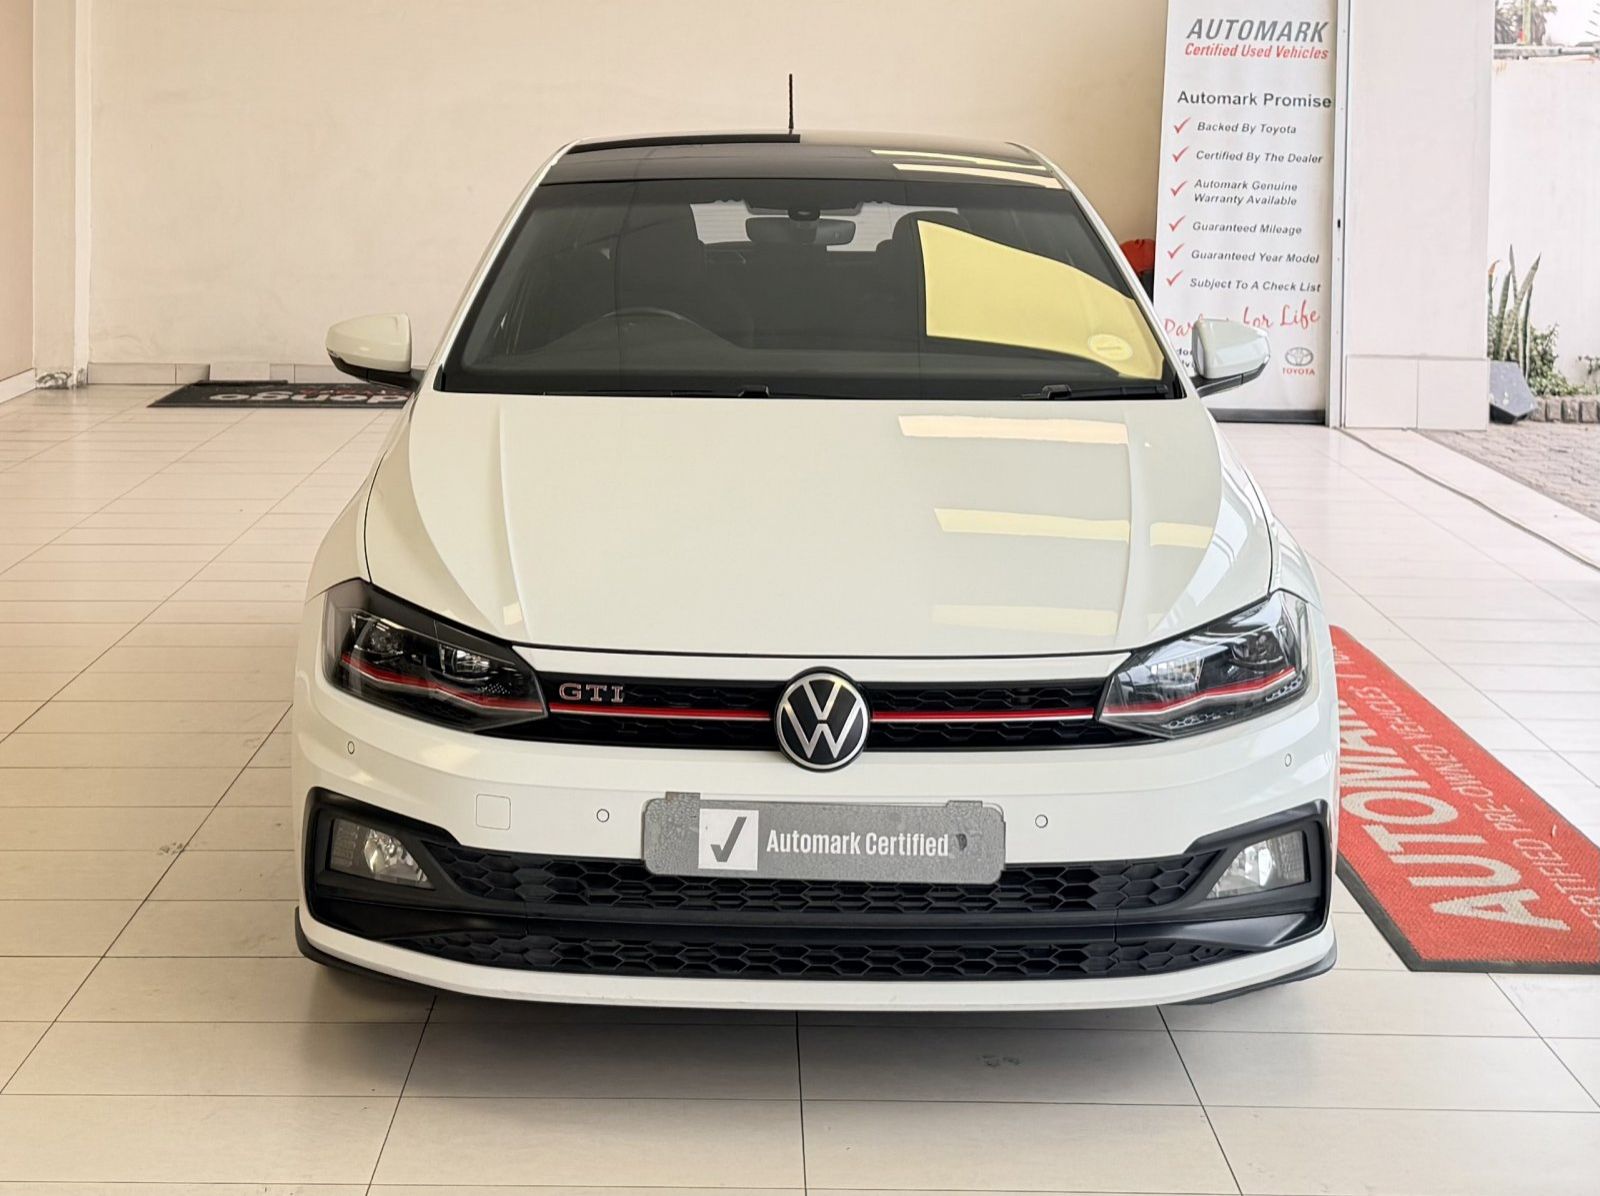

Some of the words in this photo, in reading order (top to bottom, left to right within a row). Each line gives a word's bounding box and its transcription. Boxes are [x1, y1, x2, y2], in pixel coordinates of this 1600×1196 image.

[1186, 18, 1329, 43] AUTOMARK
[1185, 42, 1237, 57] Certified
[1241, 44, 1271, 58] Used
[1276, 45, 1329, 60] Vehicles
[1177, 91, 1258, 106] Automark
[1263, 93, 1332, 109] Promise
[1197, 121, 1239, 133] Backed
[1241, 123, 1256, 134] By
[1260, 124, 1297, 135] Toyota
[1196, 150, 1243, 162] Certified
[1246, 152, 1260, 163] By
[1264, 152, 1284, 163] The
[1288, 153, 1323, 164] Dealer
[1194, 179, 1248, 190] Automark
[1252, 180, 1298, 192] Genuine
[1194, 193, 1244, 206] Warranty
[1247, 195, 1297, 206] Available
[1192, 221, 1257, 233] Guaranteed
[1259, 224, 1302, 236] Mileage
[1191, 250, 1255, 262] Guaranteed
[1259, 252, 1283, 263] Year
[1285, 253, 1320, 264] Model
[1189, 278, 1232, 290] Subject
[1235, 280, 1248, 290] To
[1251, 280, 1260, 290] A
[1262, 281, 1296, 291] Check
[1300, 282, 1321, 292] List
[1280, 299, 1320, 330] Life
[1282, 367, 1316, 376] TOYOTA
[558, 682, 625, 703] GTI
[1338, 699, 1571, 932] AUTOMA
[766, 829, 861, 855] Automark
[865, 831, 949, 858] Certified
